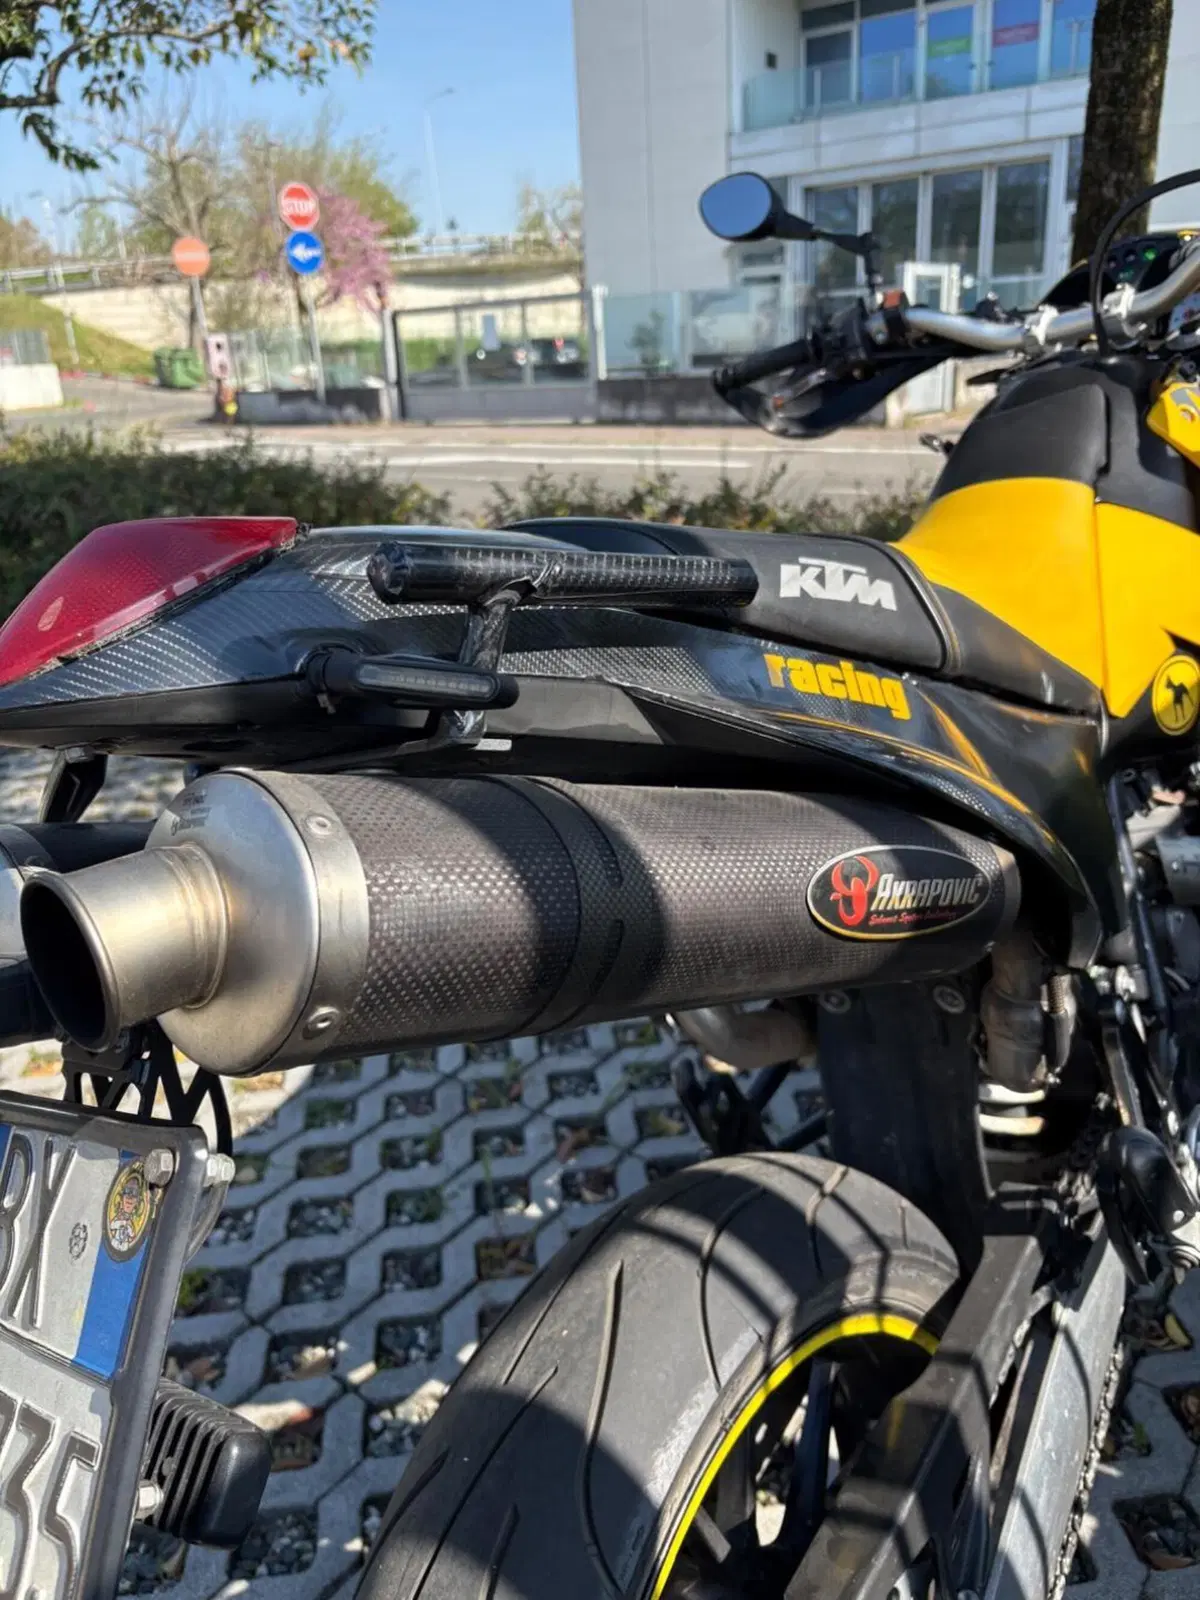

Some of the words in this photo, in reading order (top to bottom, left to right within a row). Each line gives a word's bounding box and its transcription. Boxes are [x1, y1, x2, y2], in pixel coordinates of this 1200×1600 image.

[281, 198, 317, 216] STOP
[779, 556, 897, 611] KTM
[763, 653, 912, 721] racing
